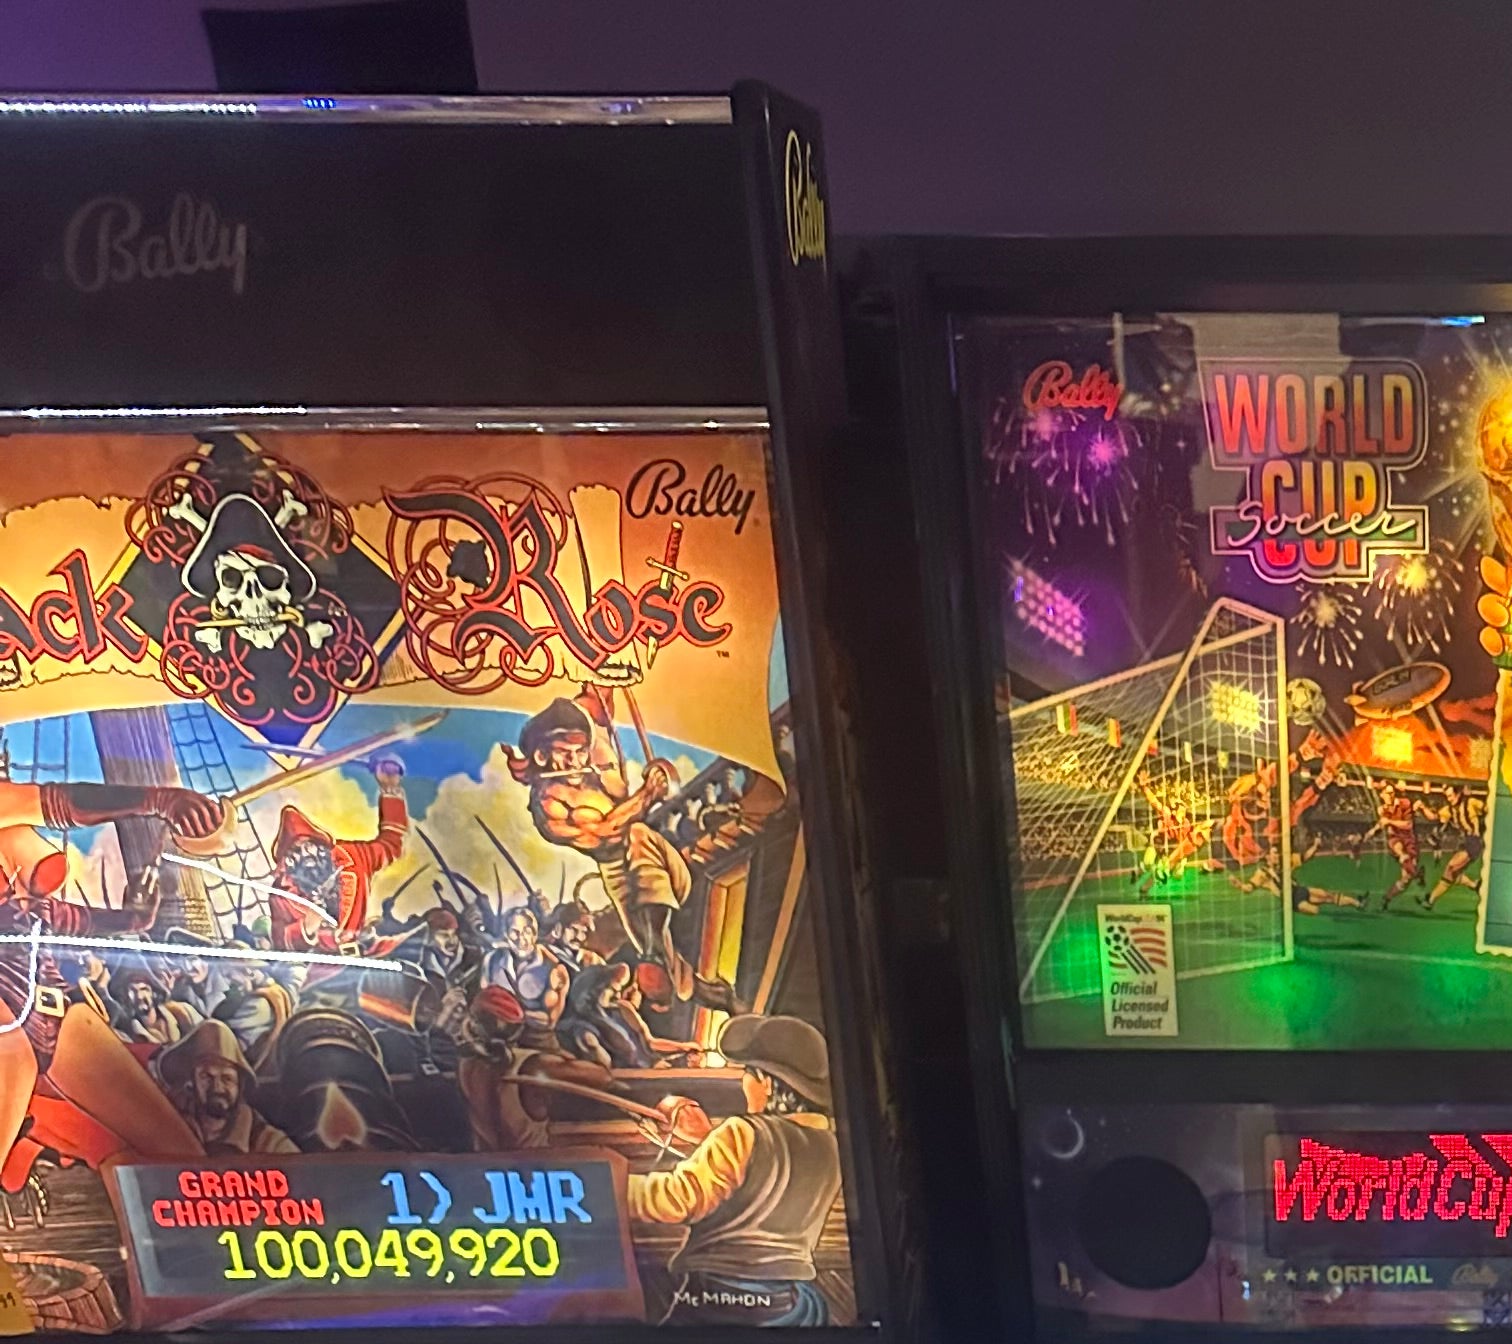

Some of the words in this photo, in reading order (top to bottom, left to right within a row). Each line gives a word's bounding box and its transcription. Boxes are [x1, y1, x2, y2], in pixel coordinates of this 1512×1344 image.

[63, 196, 251, 293] Bally
[1023, 360, 1123, 421] Bally
[1214, 373, 1413, 455] WORLD
[626, 458, 757, 534] Bally
[1262, 460, 1378, 567] CUP
[1228, 501, 1418, 547] Soccer
[382, 475, 731, 670] Rose
[1111, 981, 1159, 997] Official
[1112, 998, 1170, 1013] Licensed
[1113, 1015, 1163, 1030] Product
[152, 1199, 324, 1227] CHAMPION
[180, 1170, 289, 1199] GRAND
[472, 1170, 592, 1225] JMR
[218, 1228, 560, 1286] 100,049,920
[1326, 1265, 1433, 1285] OFFICIAL
[702, 1291, 771, 1307] MAHON
